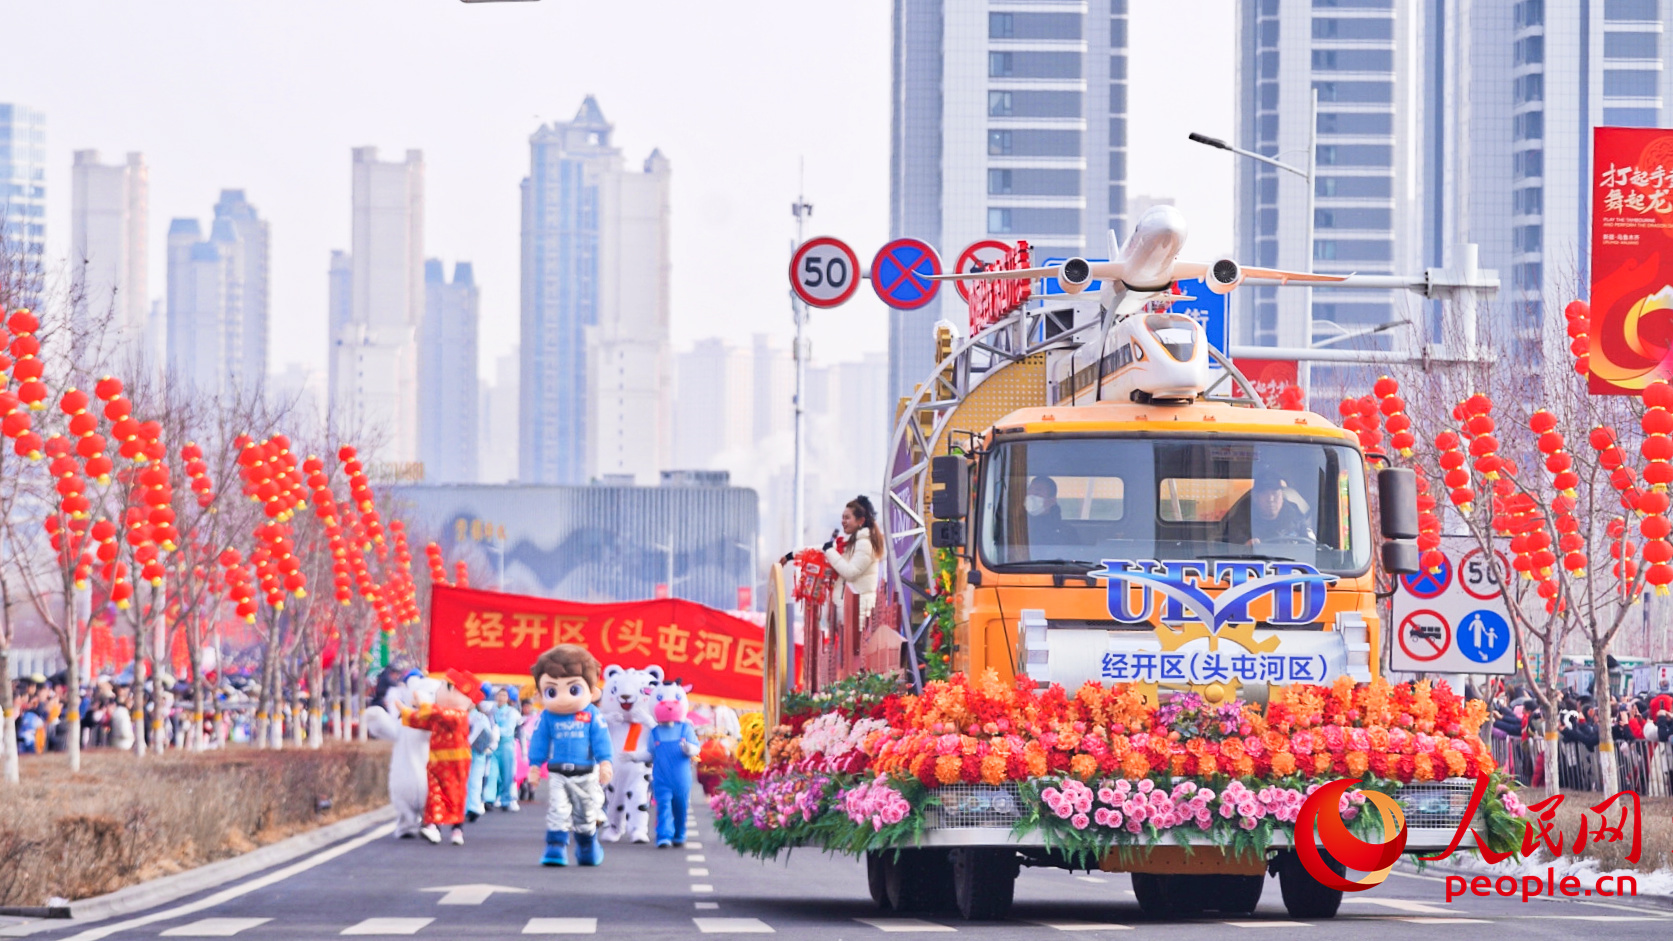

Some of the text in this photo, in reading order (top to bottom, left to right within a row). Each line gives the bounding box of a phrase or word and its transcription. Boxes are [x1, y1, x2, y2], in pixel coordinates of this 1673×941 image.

[804, 256, 847, 289] 50
[1100, 559, 1328, 626] UETD
[1102, 653, 1328, 682] 经开区(头屯河区)
